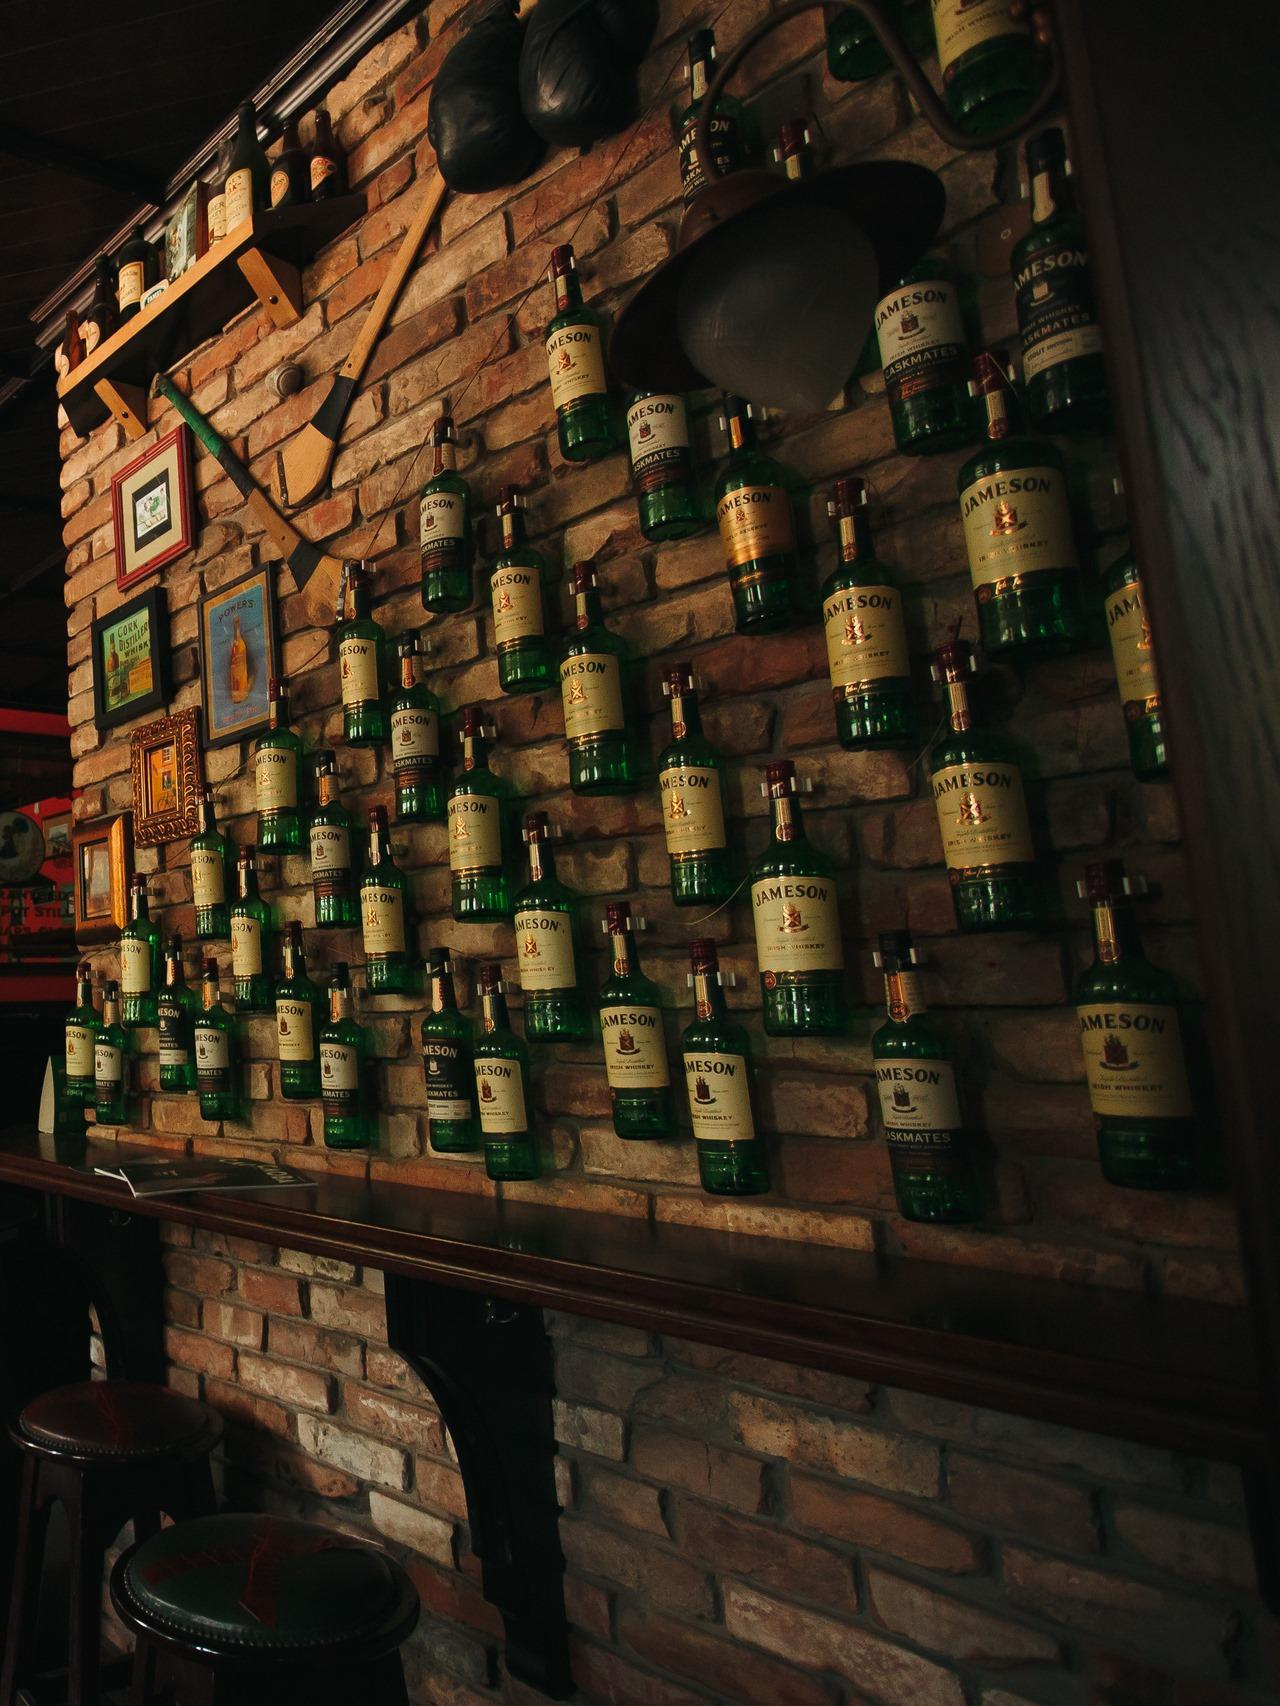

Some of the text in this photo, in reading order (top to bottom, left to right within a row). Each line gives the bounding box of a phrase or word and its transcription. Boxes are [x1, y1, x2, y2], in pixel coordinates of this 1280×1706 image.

[1014, 250, 1088, 291] AMESON
[877, 290, 948, 331] JAMESON
[628, 403, 674, 427] AMESON
[964, 478, 1051, 517] JAMESON
[118, 618, 138, 638] CORK
[119, 622, 148, 652] DISTILLER
[124, 641, 149, 658] WHISK
[392, 715, 429, 730] AMESON
[756, 884, 828, 907] JAMESON
[515, 919, 560, 932] AMESON
[1080, 1013, 1165, 1035] AMESON
[876, 1067, 940, 1085] AMESON
